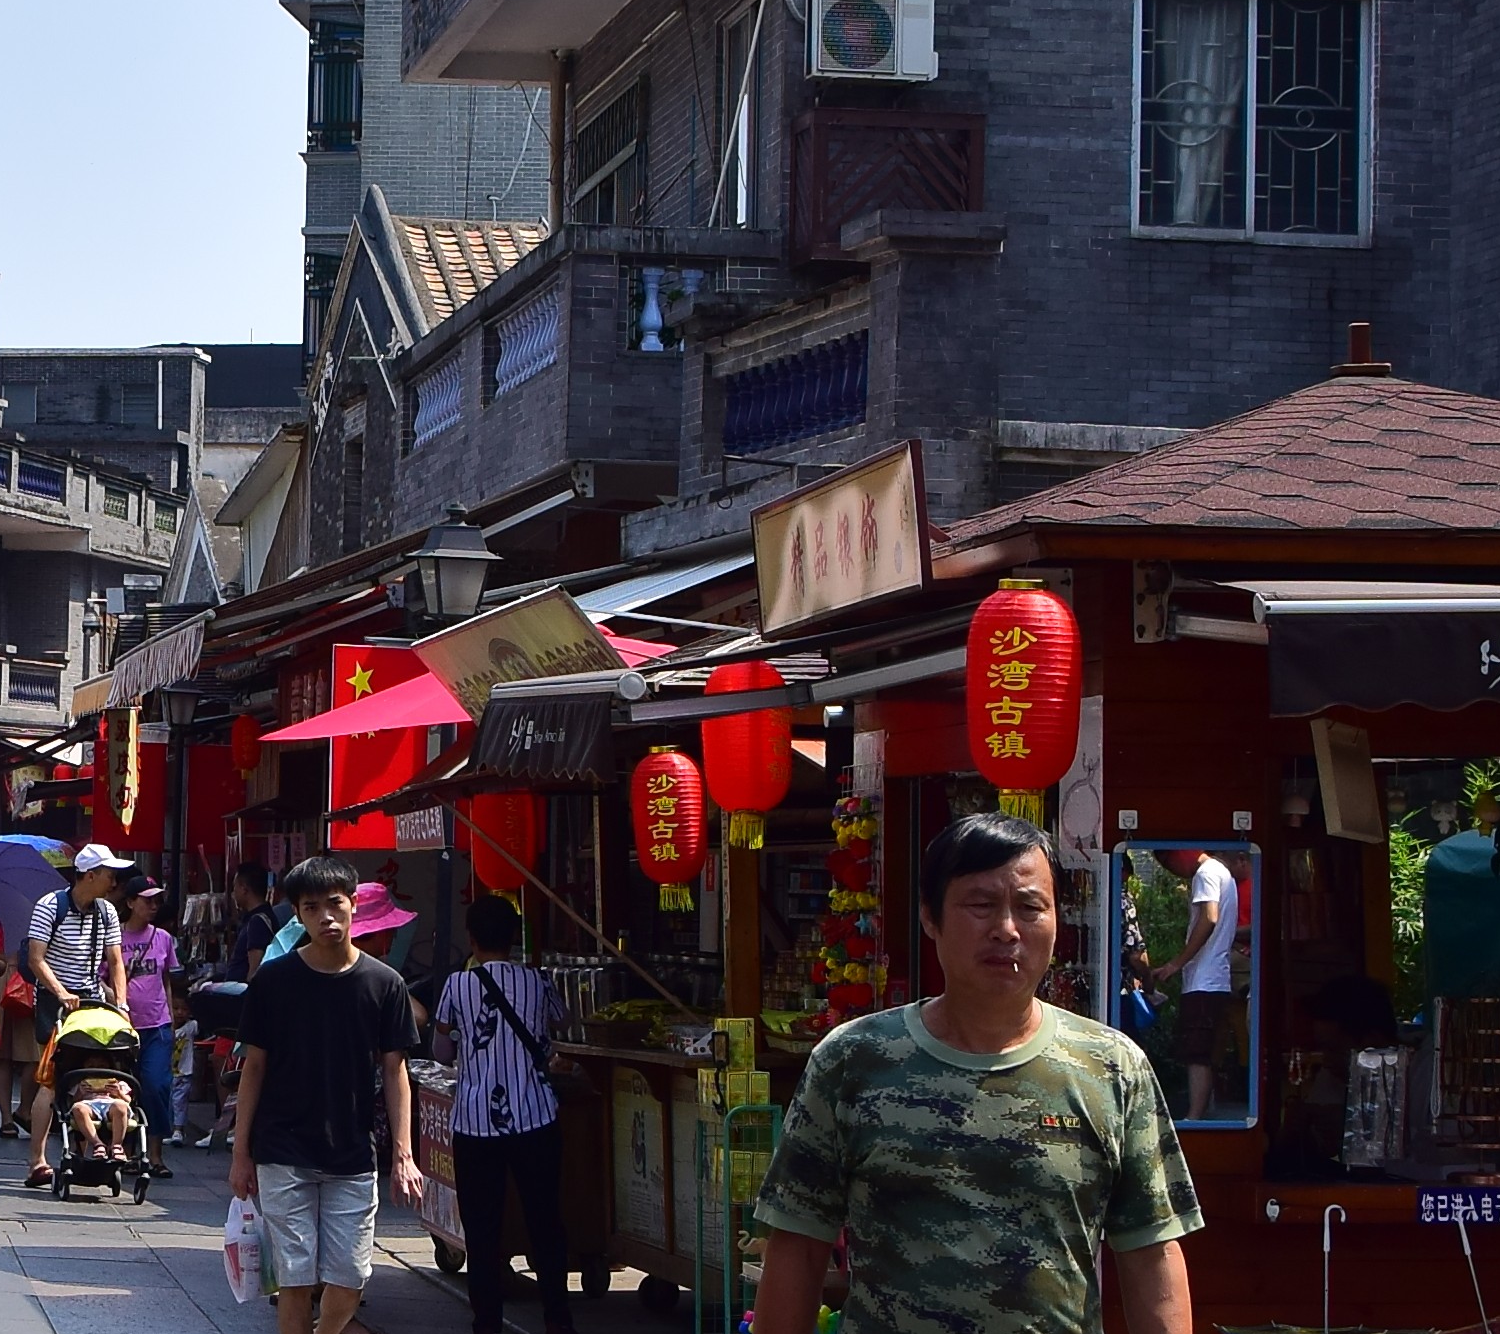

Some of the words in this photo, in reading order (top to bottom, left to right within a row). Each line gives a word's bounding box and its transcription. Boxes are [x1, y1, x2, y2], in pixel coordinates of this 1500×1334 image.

[985, 626, 1038, 759] 沙湾古镇
[646, 773, 681, 862] 沙湾古镇
